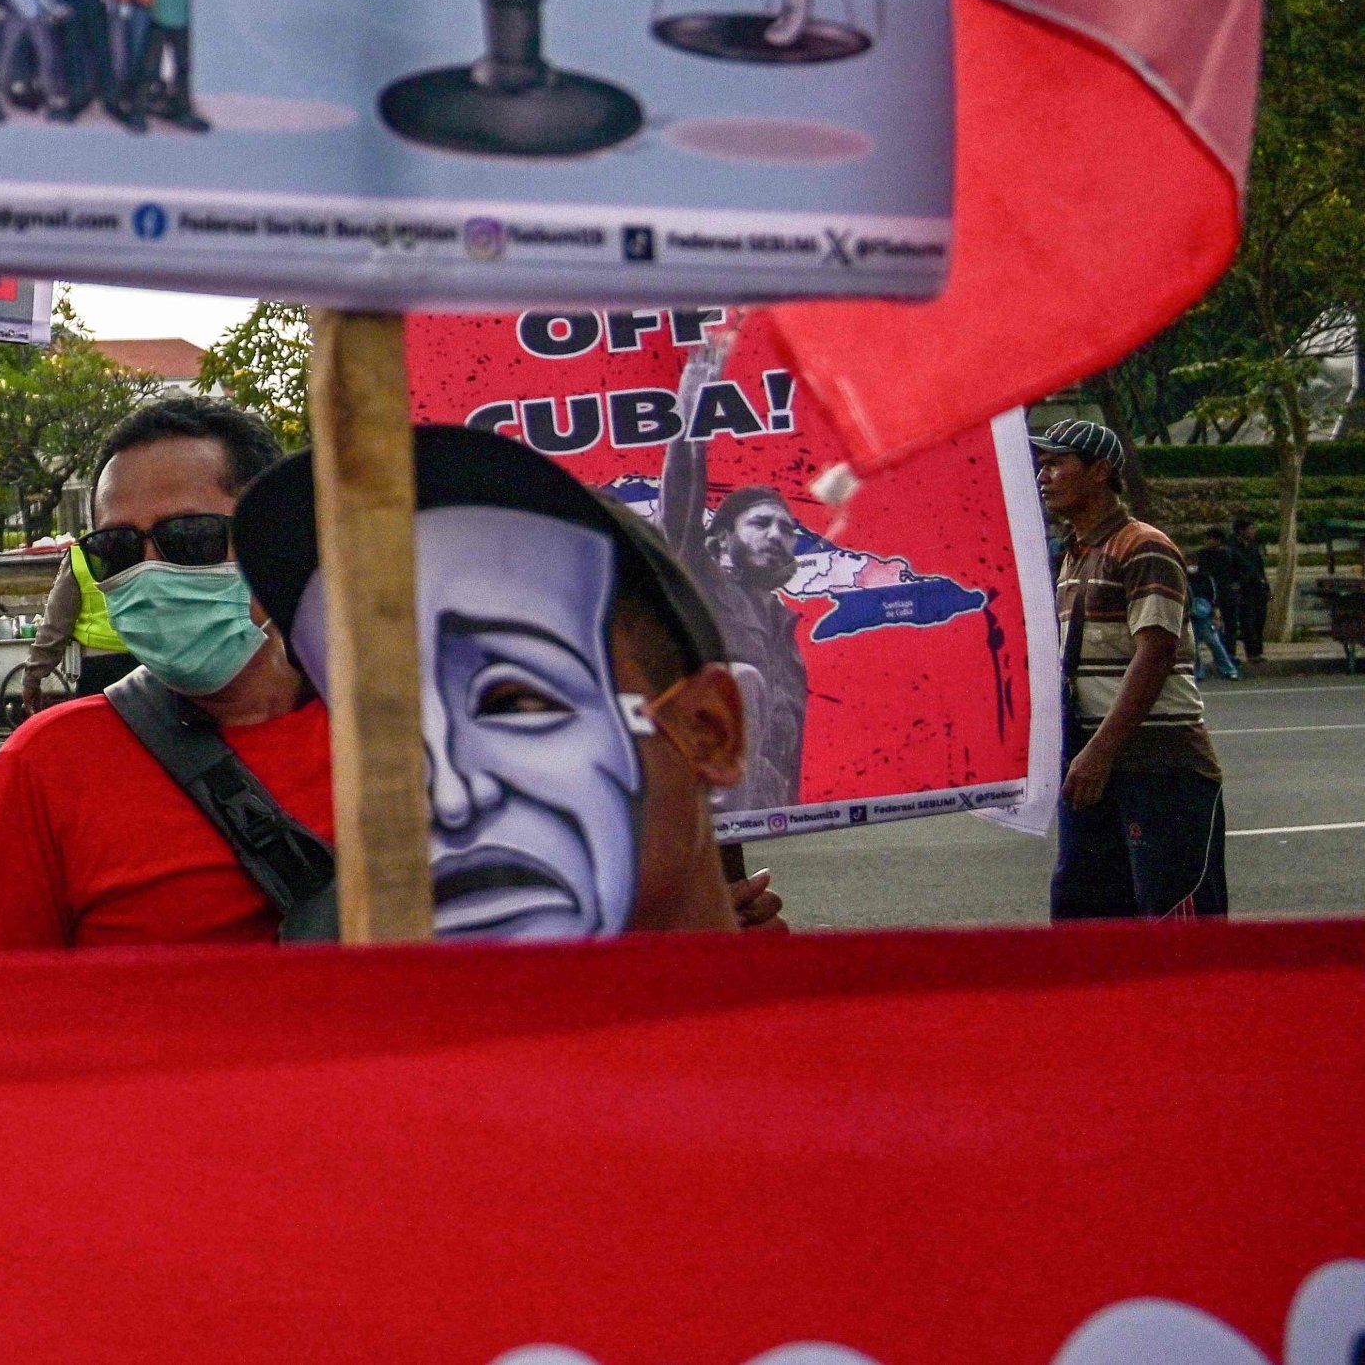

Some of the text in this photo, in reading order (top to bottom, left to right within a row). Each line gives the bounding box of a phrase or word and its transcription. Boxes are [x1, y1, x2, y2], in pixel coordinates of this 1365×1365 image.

[516, 307, 726, 359] OFF
[465, 369, 795, 455] CUBA!
[789, 810, 841, 823] fsebumi19
[873, 803, 915, 814] Federasi
[917, 798, 956, 809] SEBUMI
